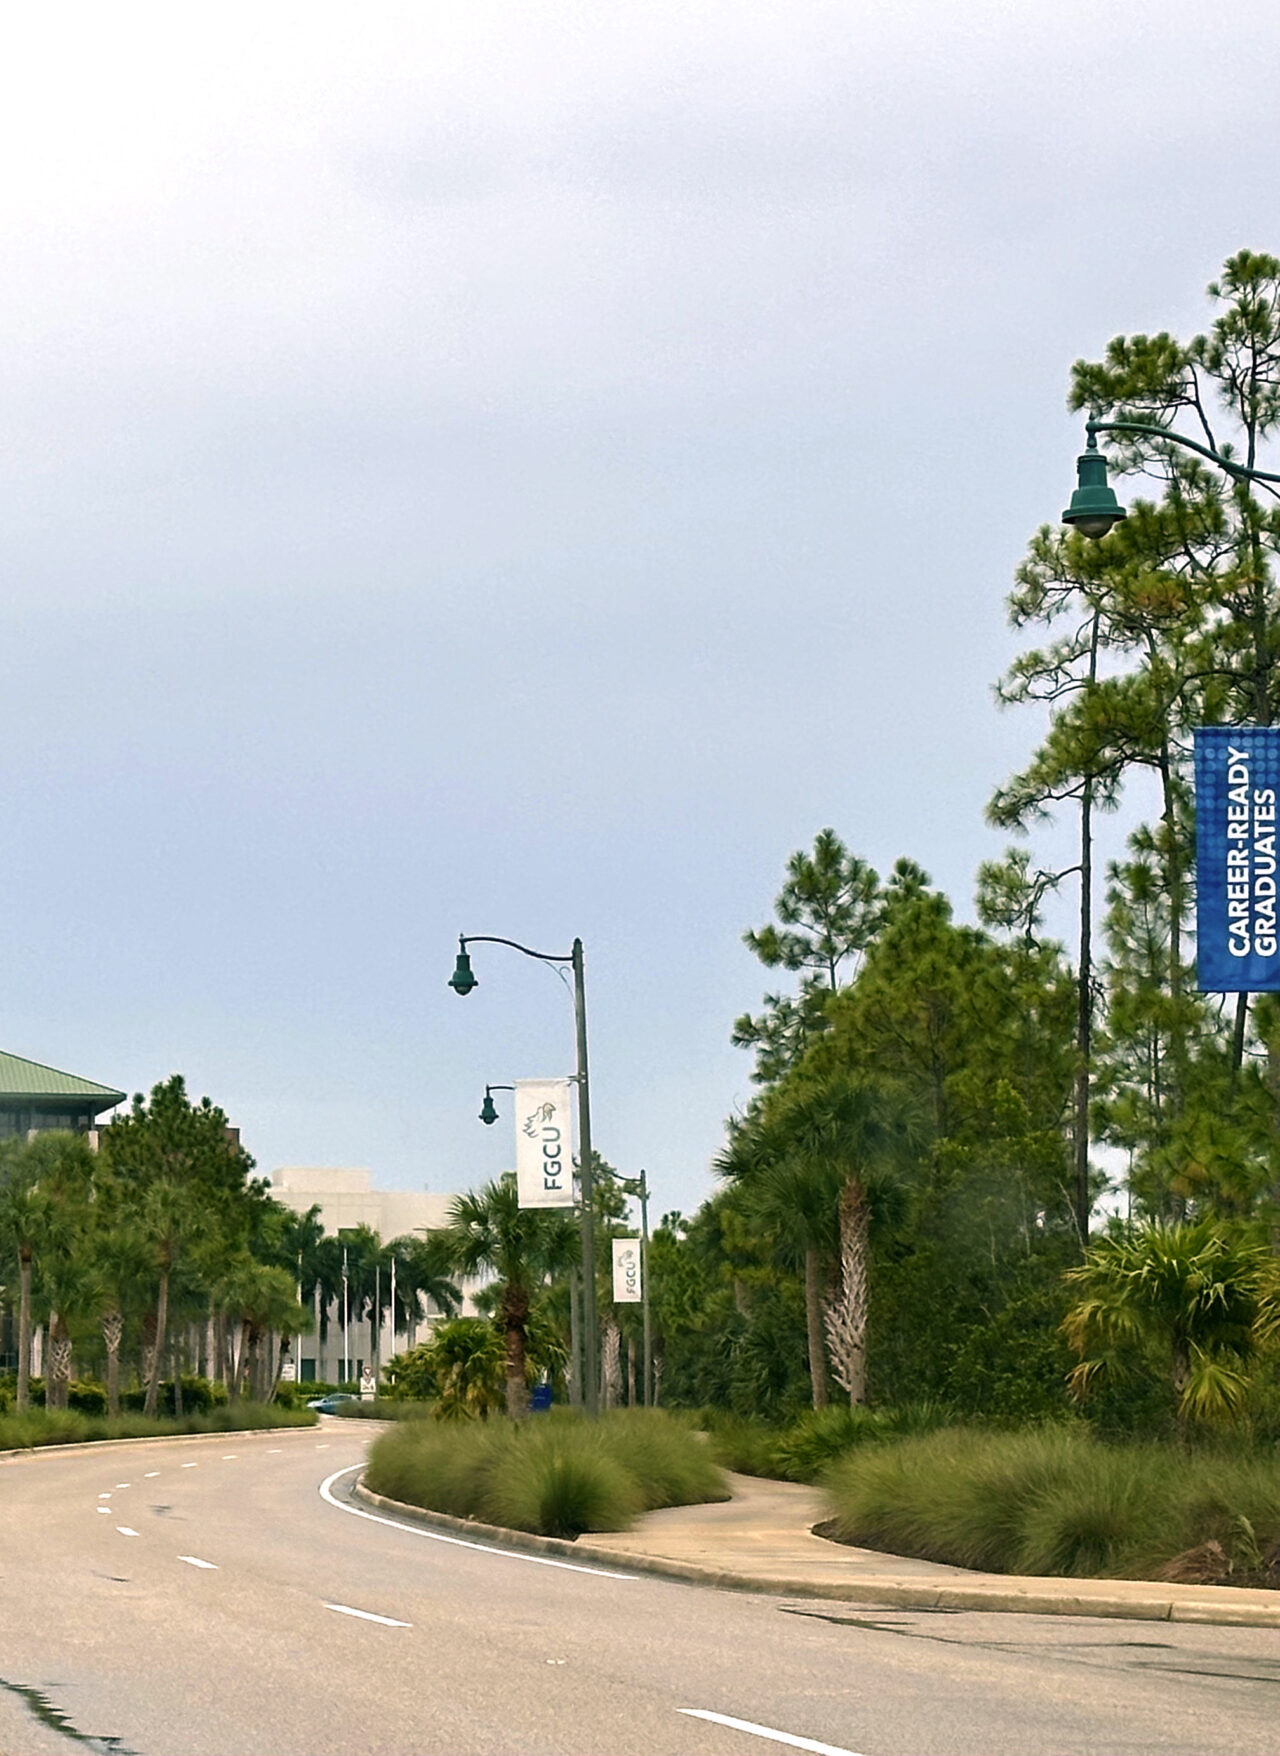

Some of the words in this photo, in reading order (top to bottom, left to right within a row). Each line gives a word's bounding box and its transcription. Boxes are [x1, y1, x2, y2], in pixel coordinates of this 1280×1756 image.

[1227, 746, 1250, 957] CAREER-READY
[1254, 788, 1277, 957] GRADUATES
[542, 1126, 562, 1190] FGCU
